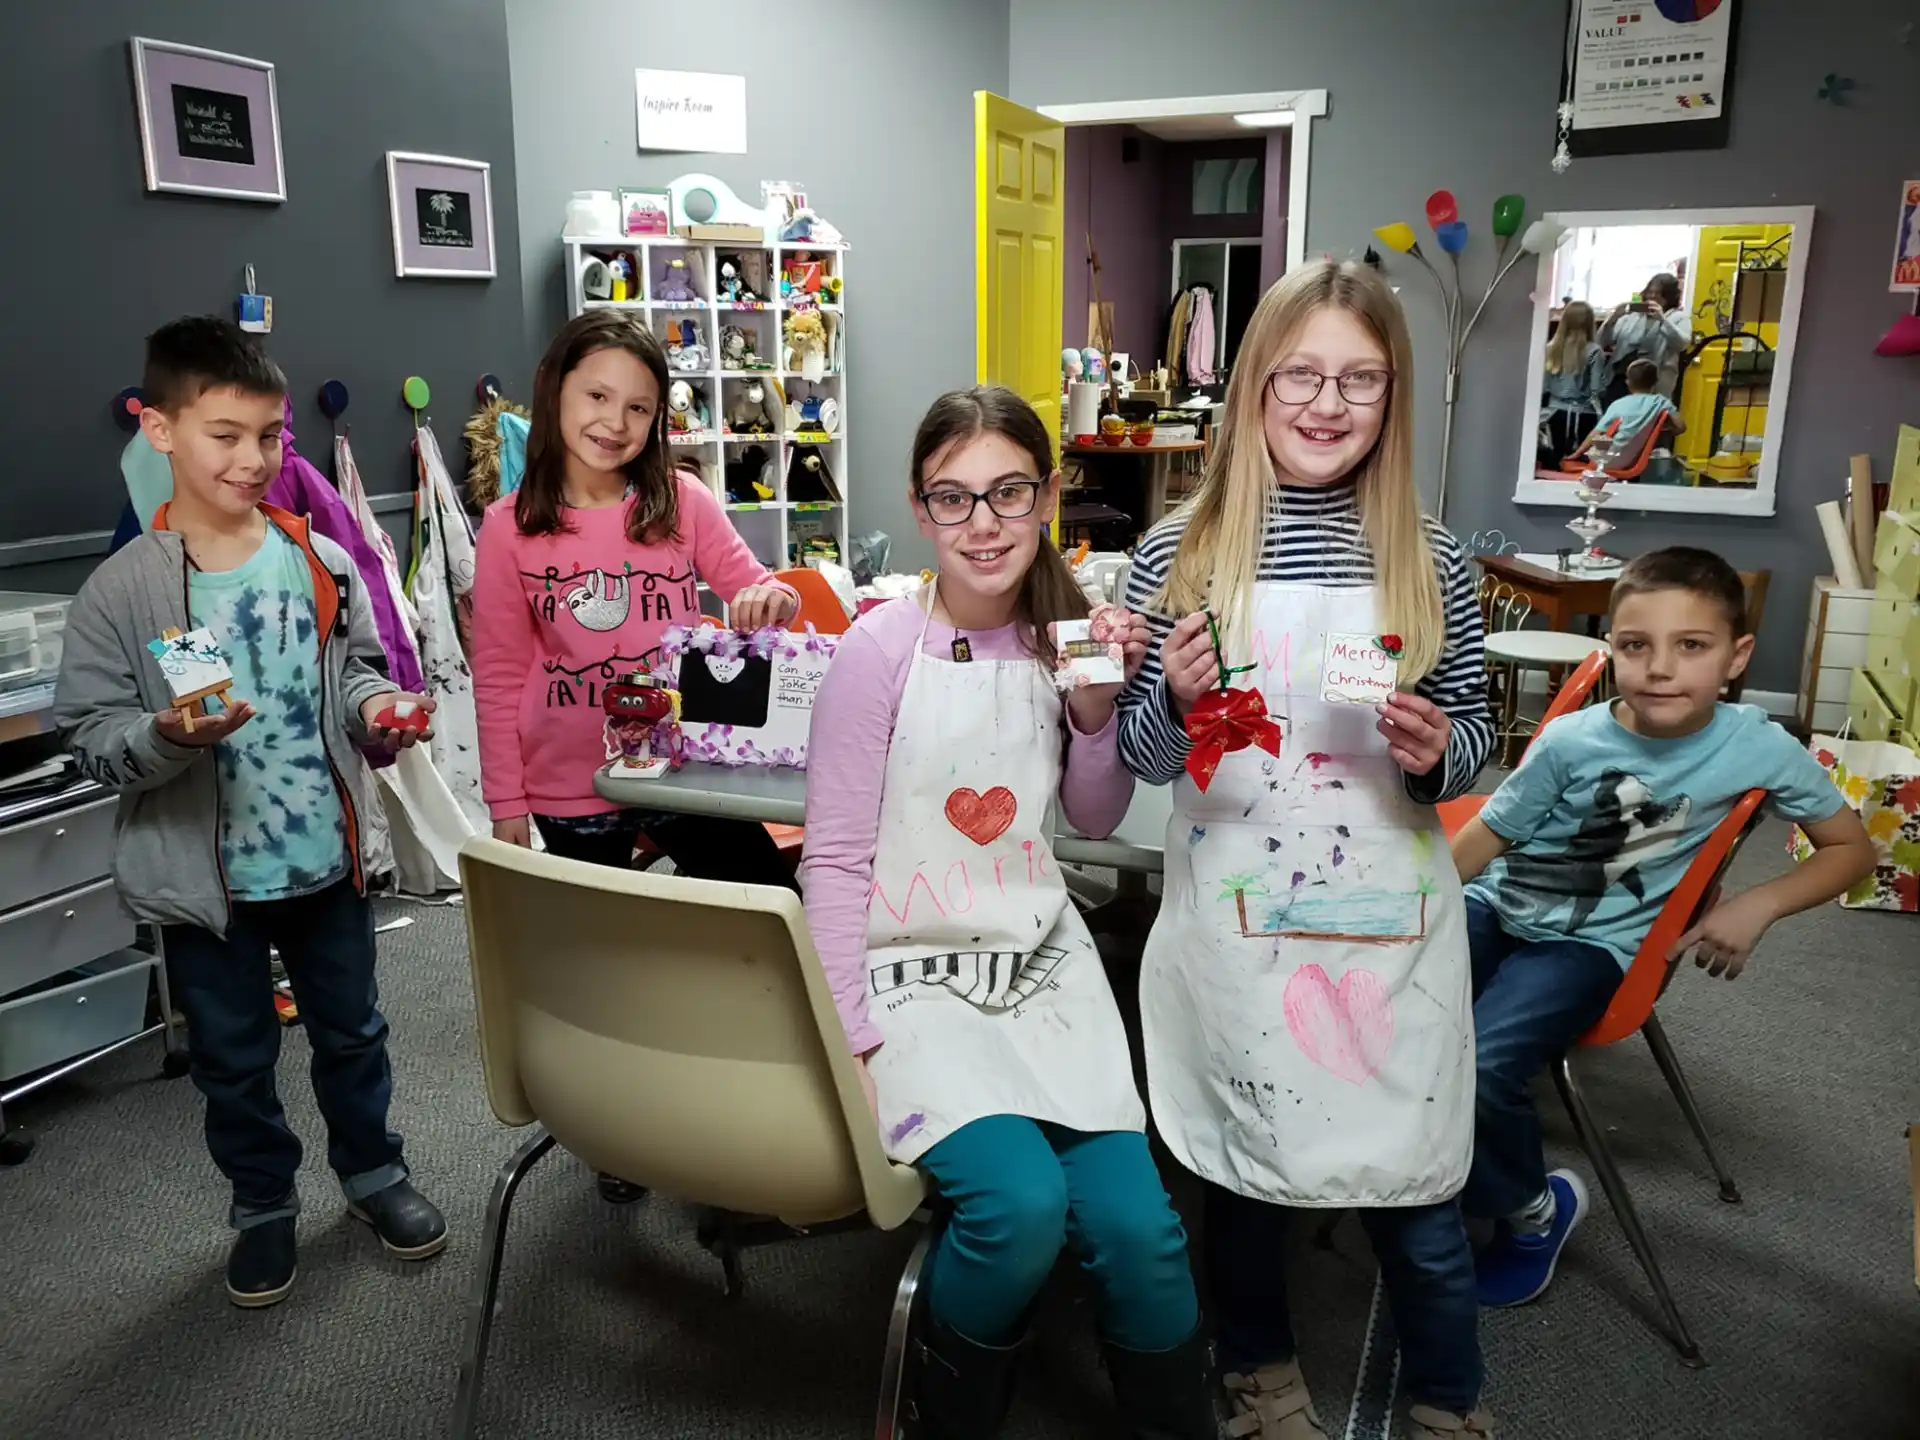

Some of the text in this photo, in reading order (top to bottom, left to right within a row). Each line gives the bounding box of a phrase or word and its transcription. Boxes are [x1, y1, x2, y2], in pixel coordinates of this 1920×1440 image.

[1585, 27, 1626, 38] VALUE
[641, 593, 672, 622] FA
[1332, 643, 1386, 671] Merry
[777, 663, 799, 674] Can
[1327, 670, 1395, 689] Christmas
[546, 679, 577, 709] FA
[776, 692, 804, 705] than
